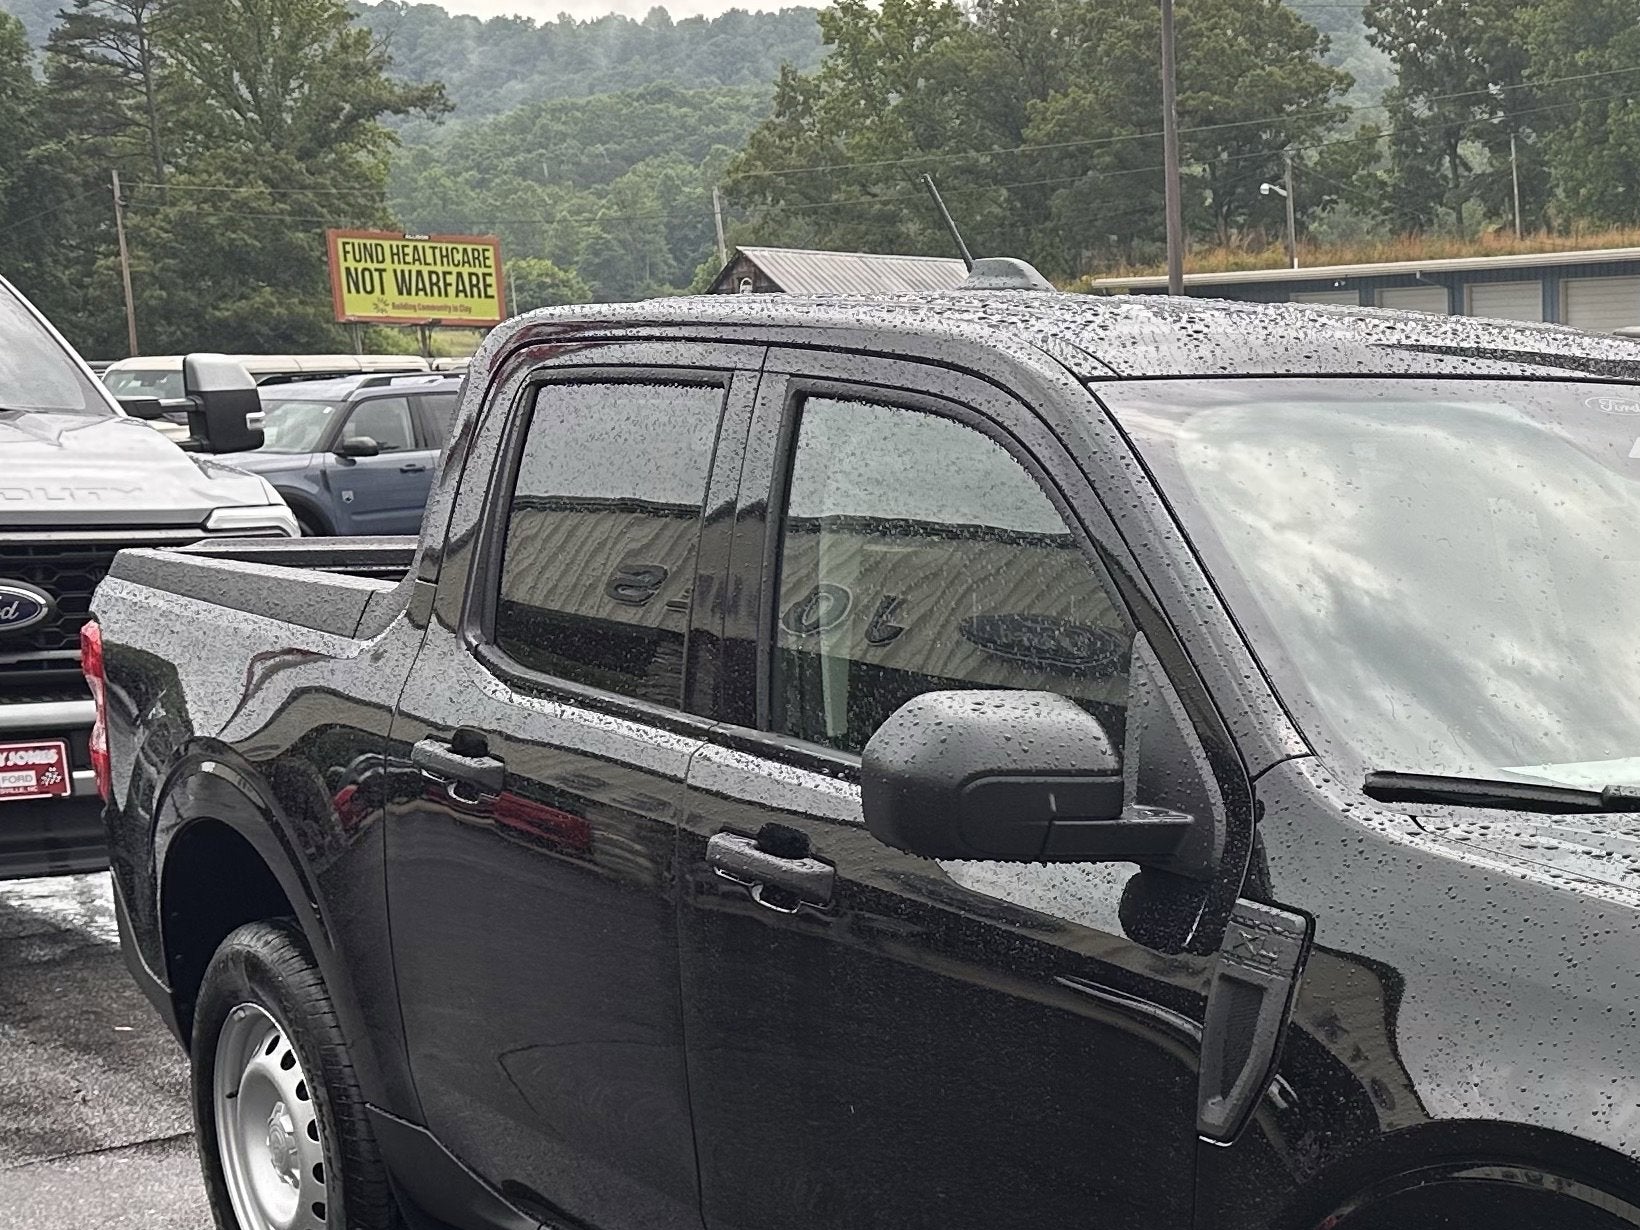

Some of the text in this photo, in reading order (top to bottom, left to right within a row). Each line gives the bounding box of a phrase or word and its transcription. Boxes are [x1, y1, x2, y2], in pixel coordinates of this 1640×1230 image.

[341, 241, 493, 269] FUND HEALTHCARE
[344, 267, 495, 299] NOT WARFARE
[7, 749, 59, 767] JONES
[2, 773, 34, 785] FORD
